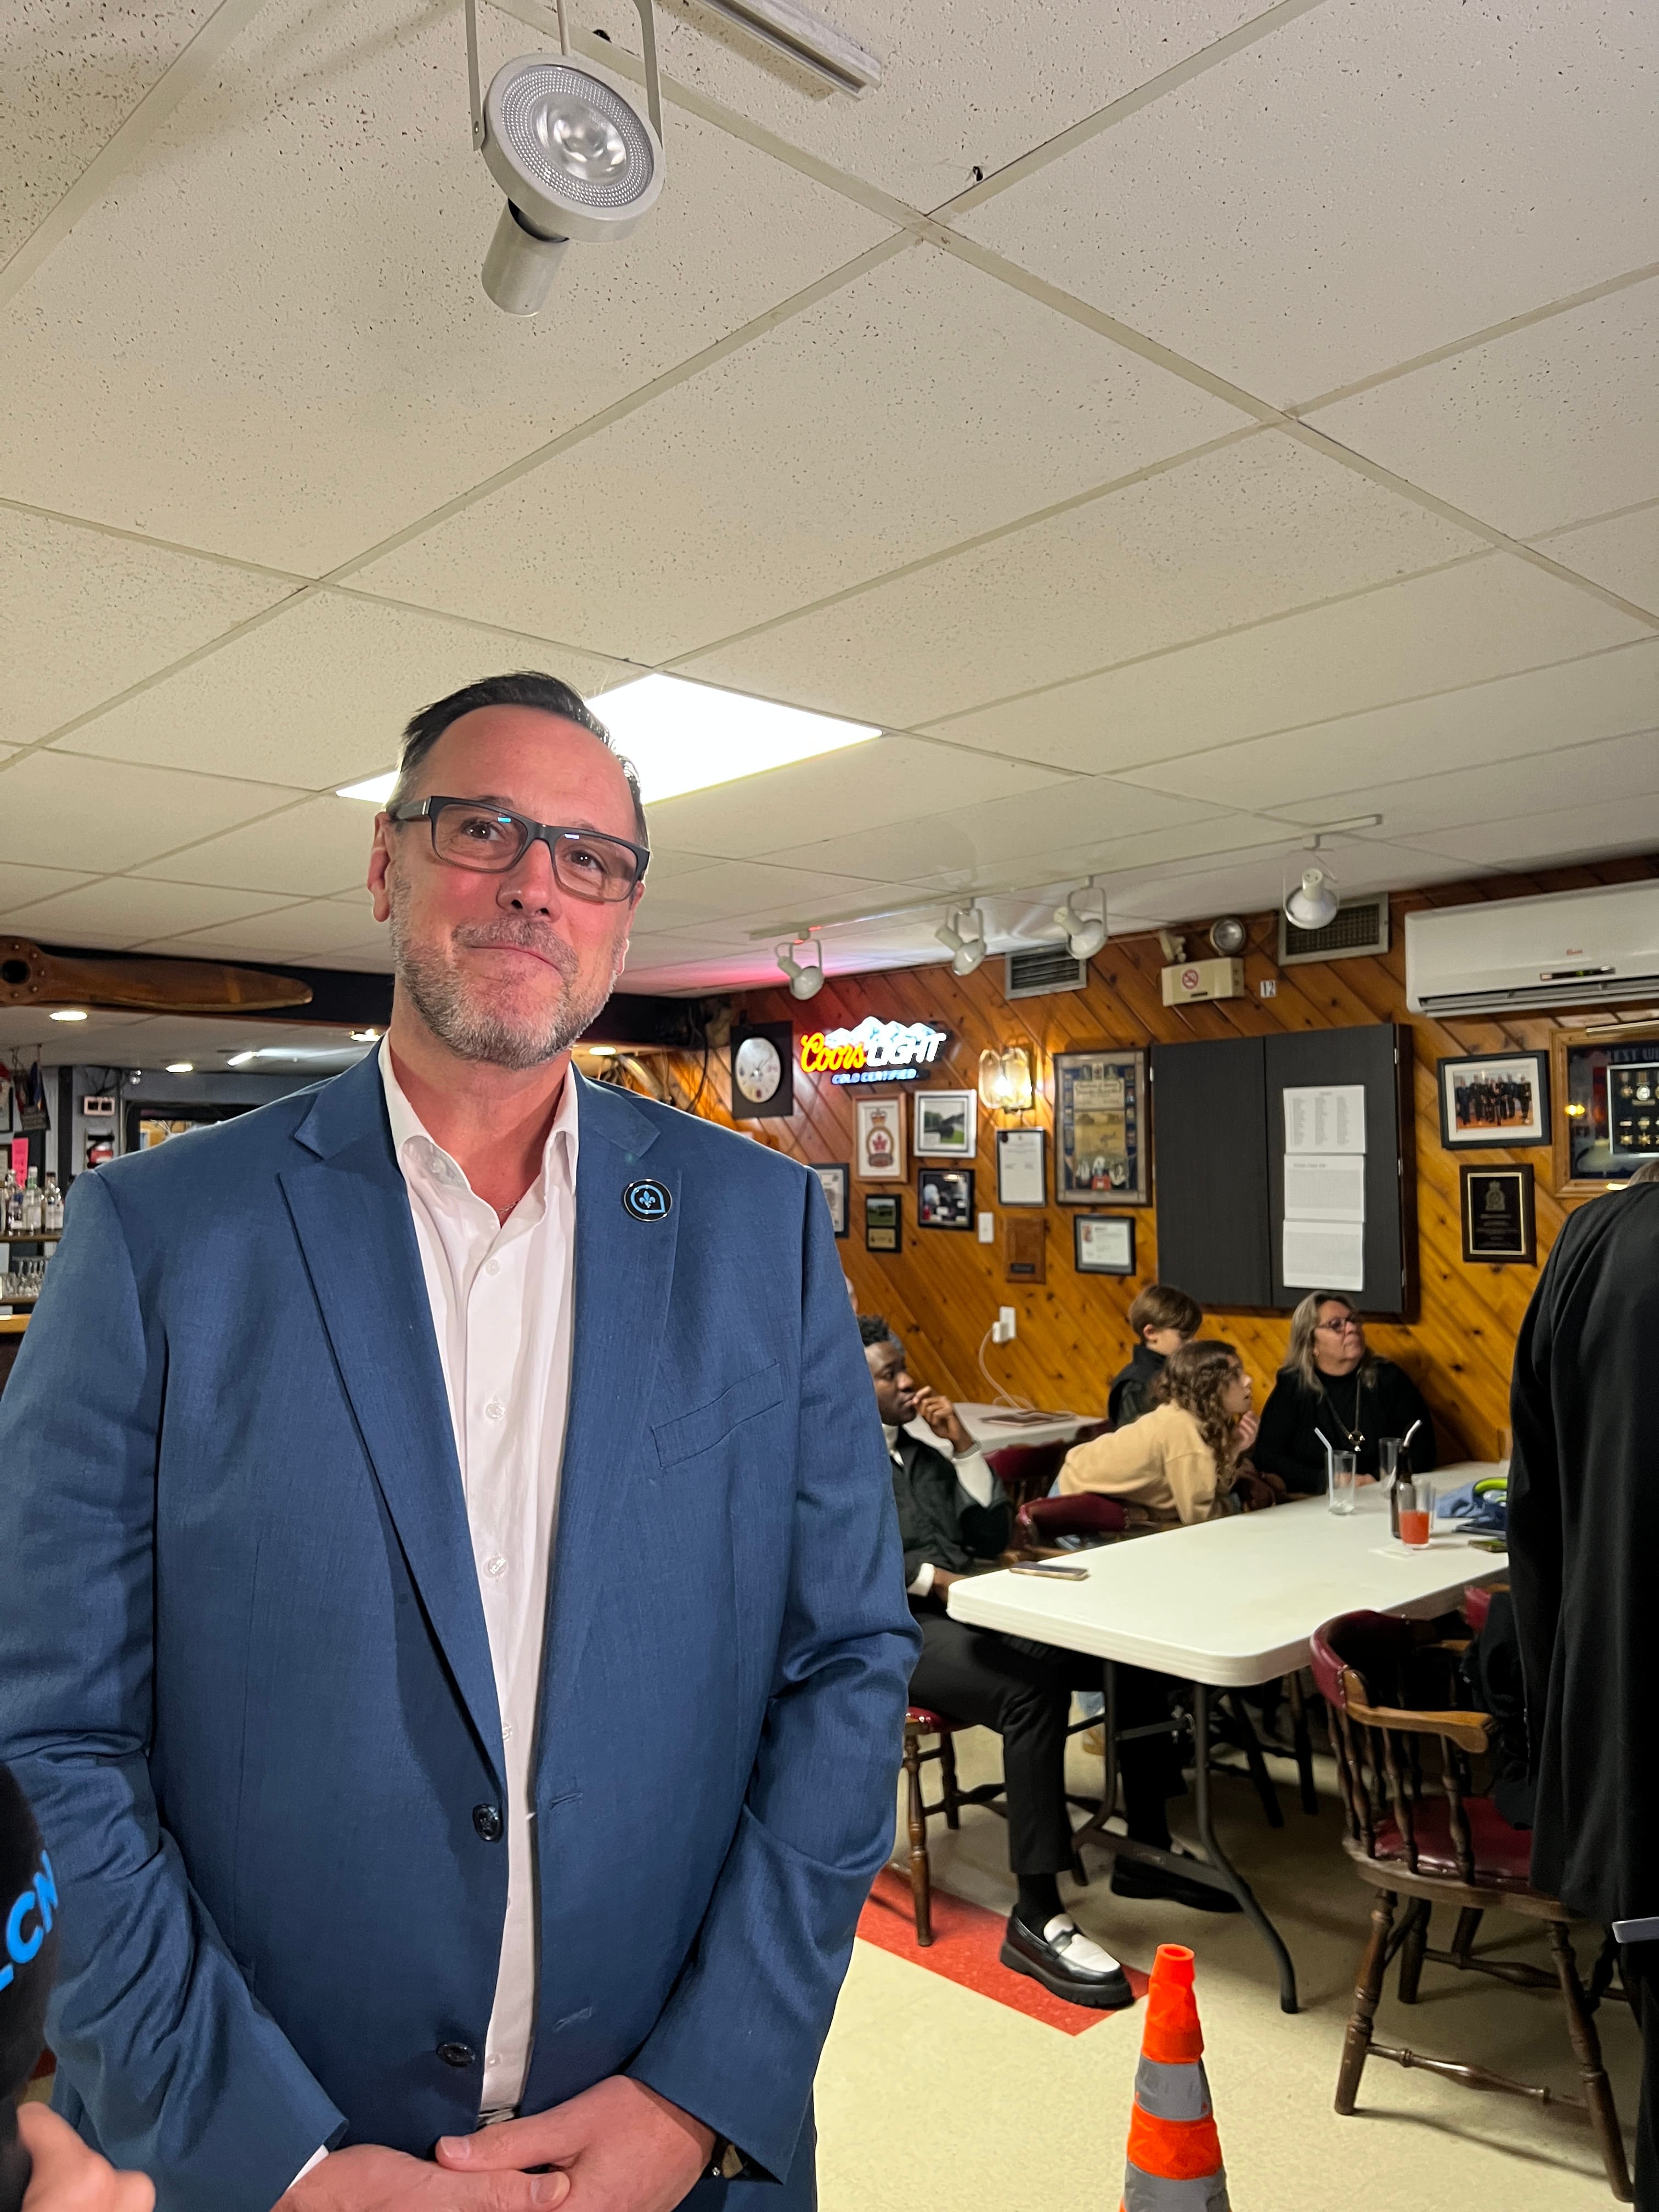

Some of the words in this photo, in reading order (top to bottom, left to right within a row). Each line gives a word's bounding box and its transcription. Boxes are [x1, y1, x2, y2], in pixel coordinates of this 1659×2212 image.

[1263, 981, 1274, 997] 12
[800, 1032, 867, 1073] Coors
[866, 1032, 947, 1067] LIGHT
[831, 1074, 860, 1085] COLD
[860, 1068, 917, 1083] CERTIFIED
[0, 1849, 59, 1993] CN
